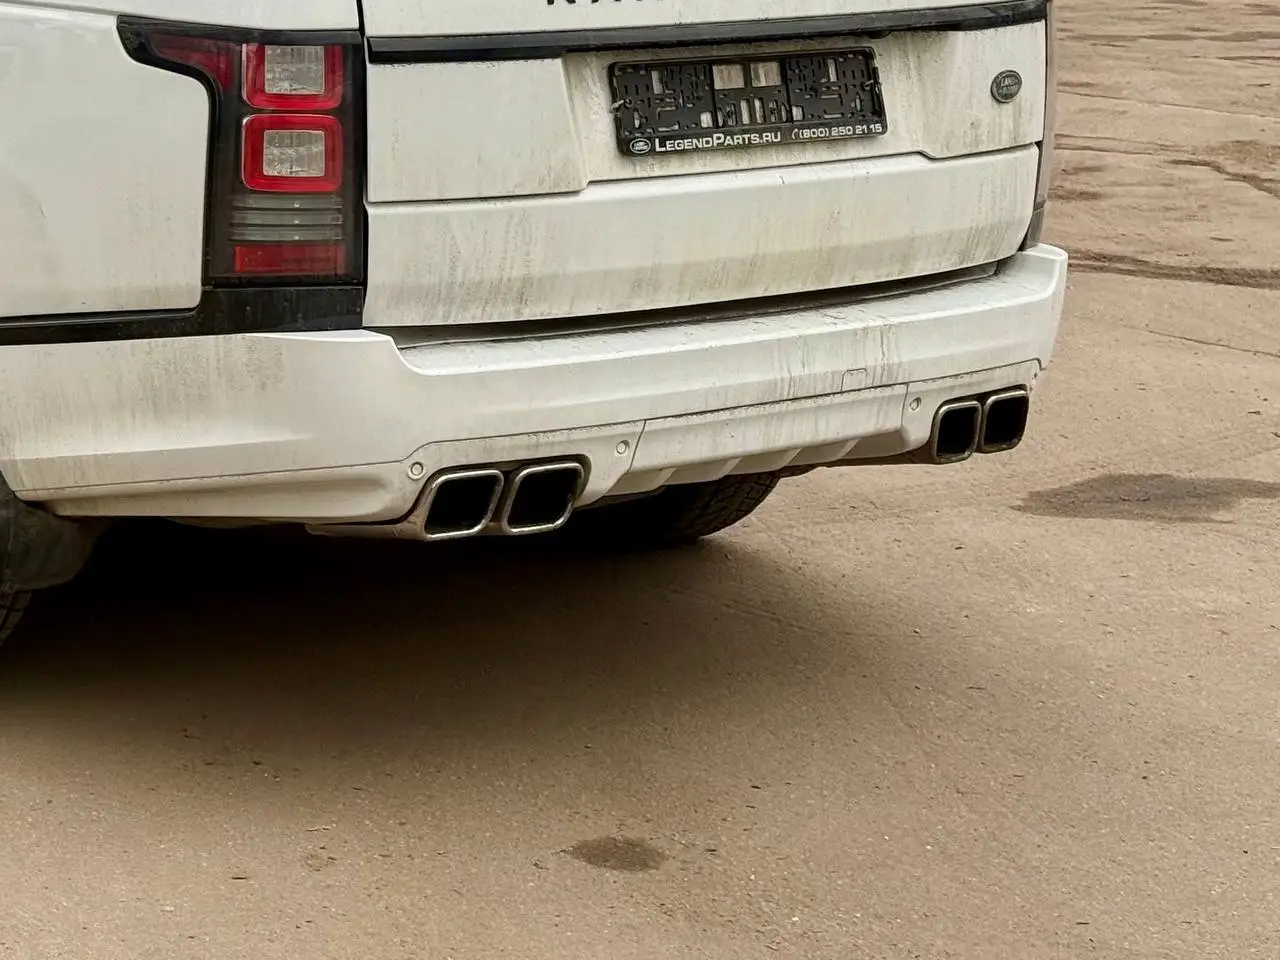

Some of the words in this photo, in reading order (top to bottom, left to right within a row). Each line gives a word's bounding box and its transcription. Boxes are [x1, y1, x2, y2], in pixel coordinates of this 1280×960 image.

[800, 127, 829, 139] (800)
[831, 126, 853, 136] 250
[855, 125, 868, 134] 21
[869, 123, 883, 133] 15
